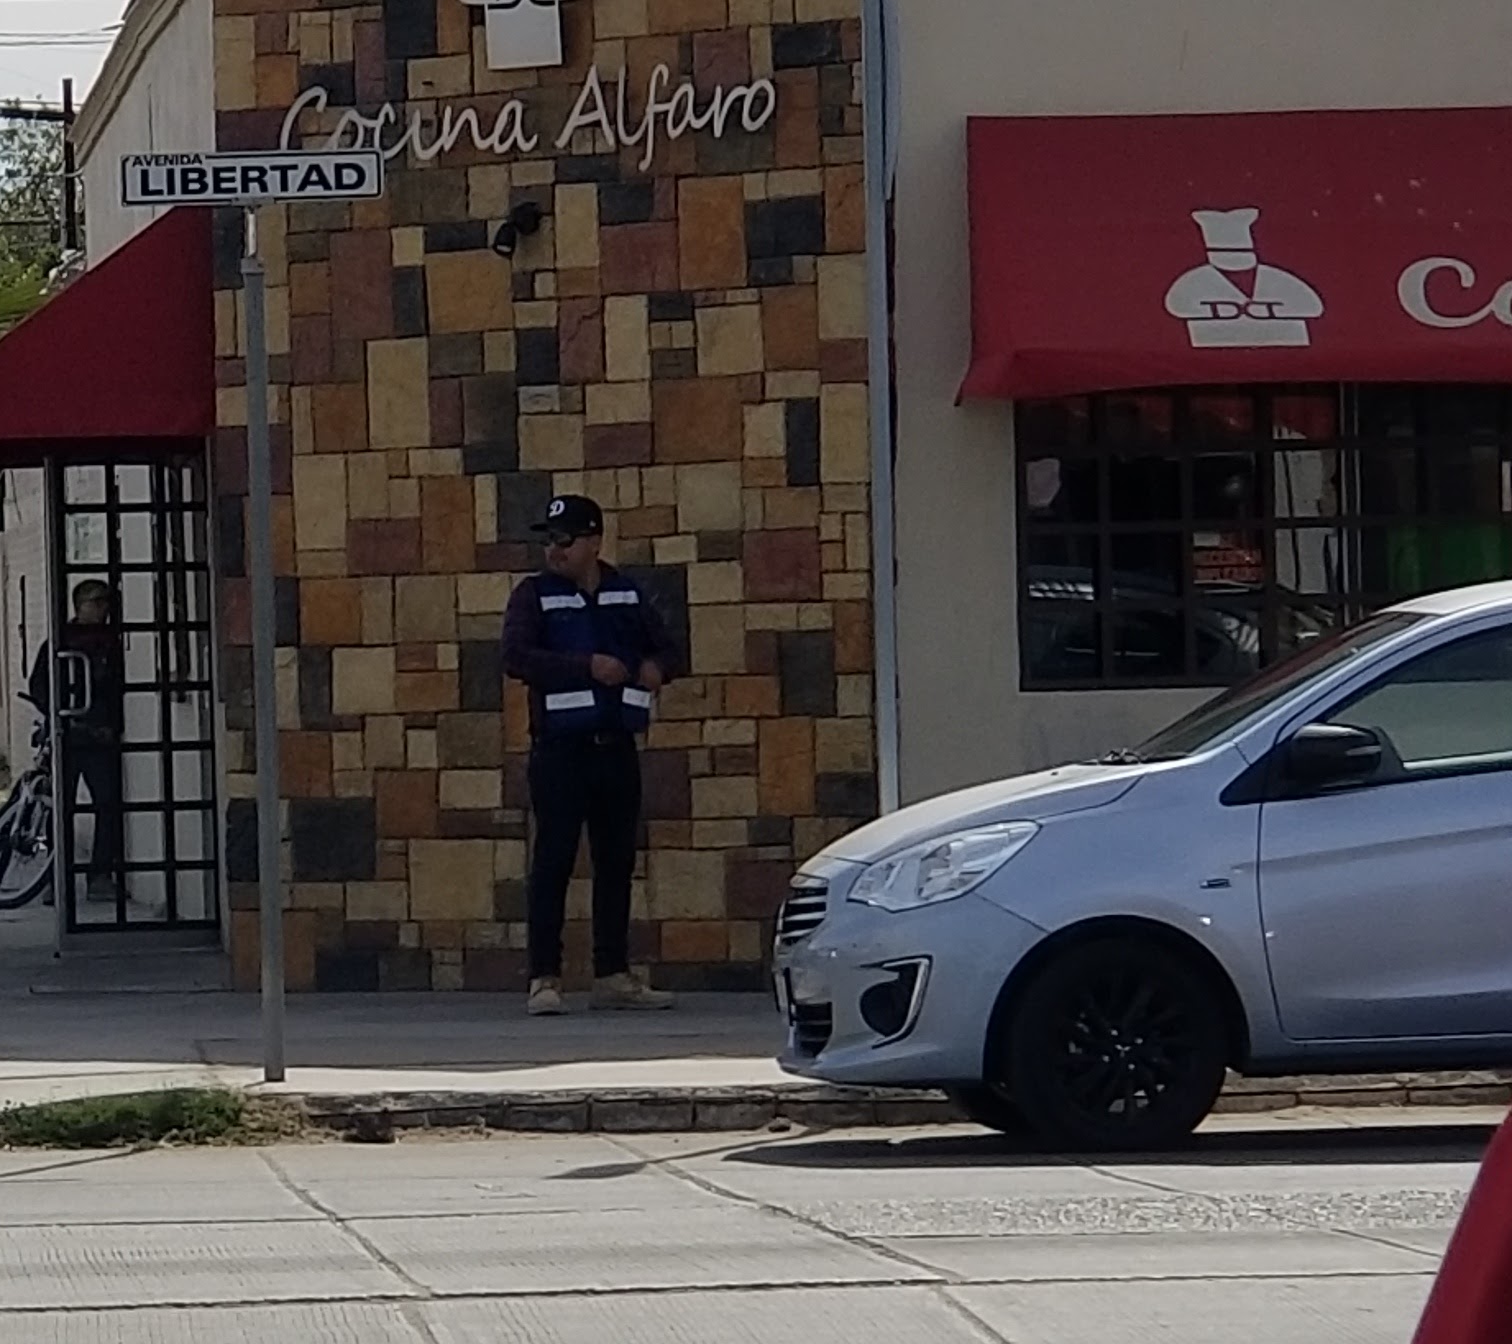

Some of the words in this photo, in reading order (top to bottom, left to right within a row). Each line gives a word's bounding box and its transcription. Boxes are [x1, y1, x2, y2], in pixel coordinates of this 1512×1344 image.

[280, 86, 537, 160] Cocina
[554, 63, 776, 172] Alfaro
[132, 153, 203, 168] AVENIDA
[140, 162, 367, 197] LIBERTAD
[548, 499, 565, 518] D
